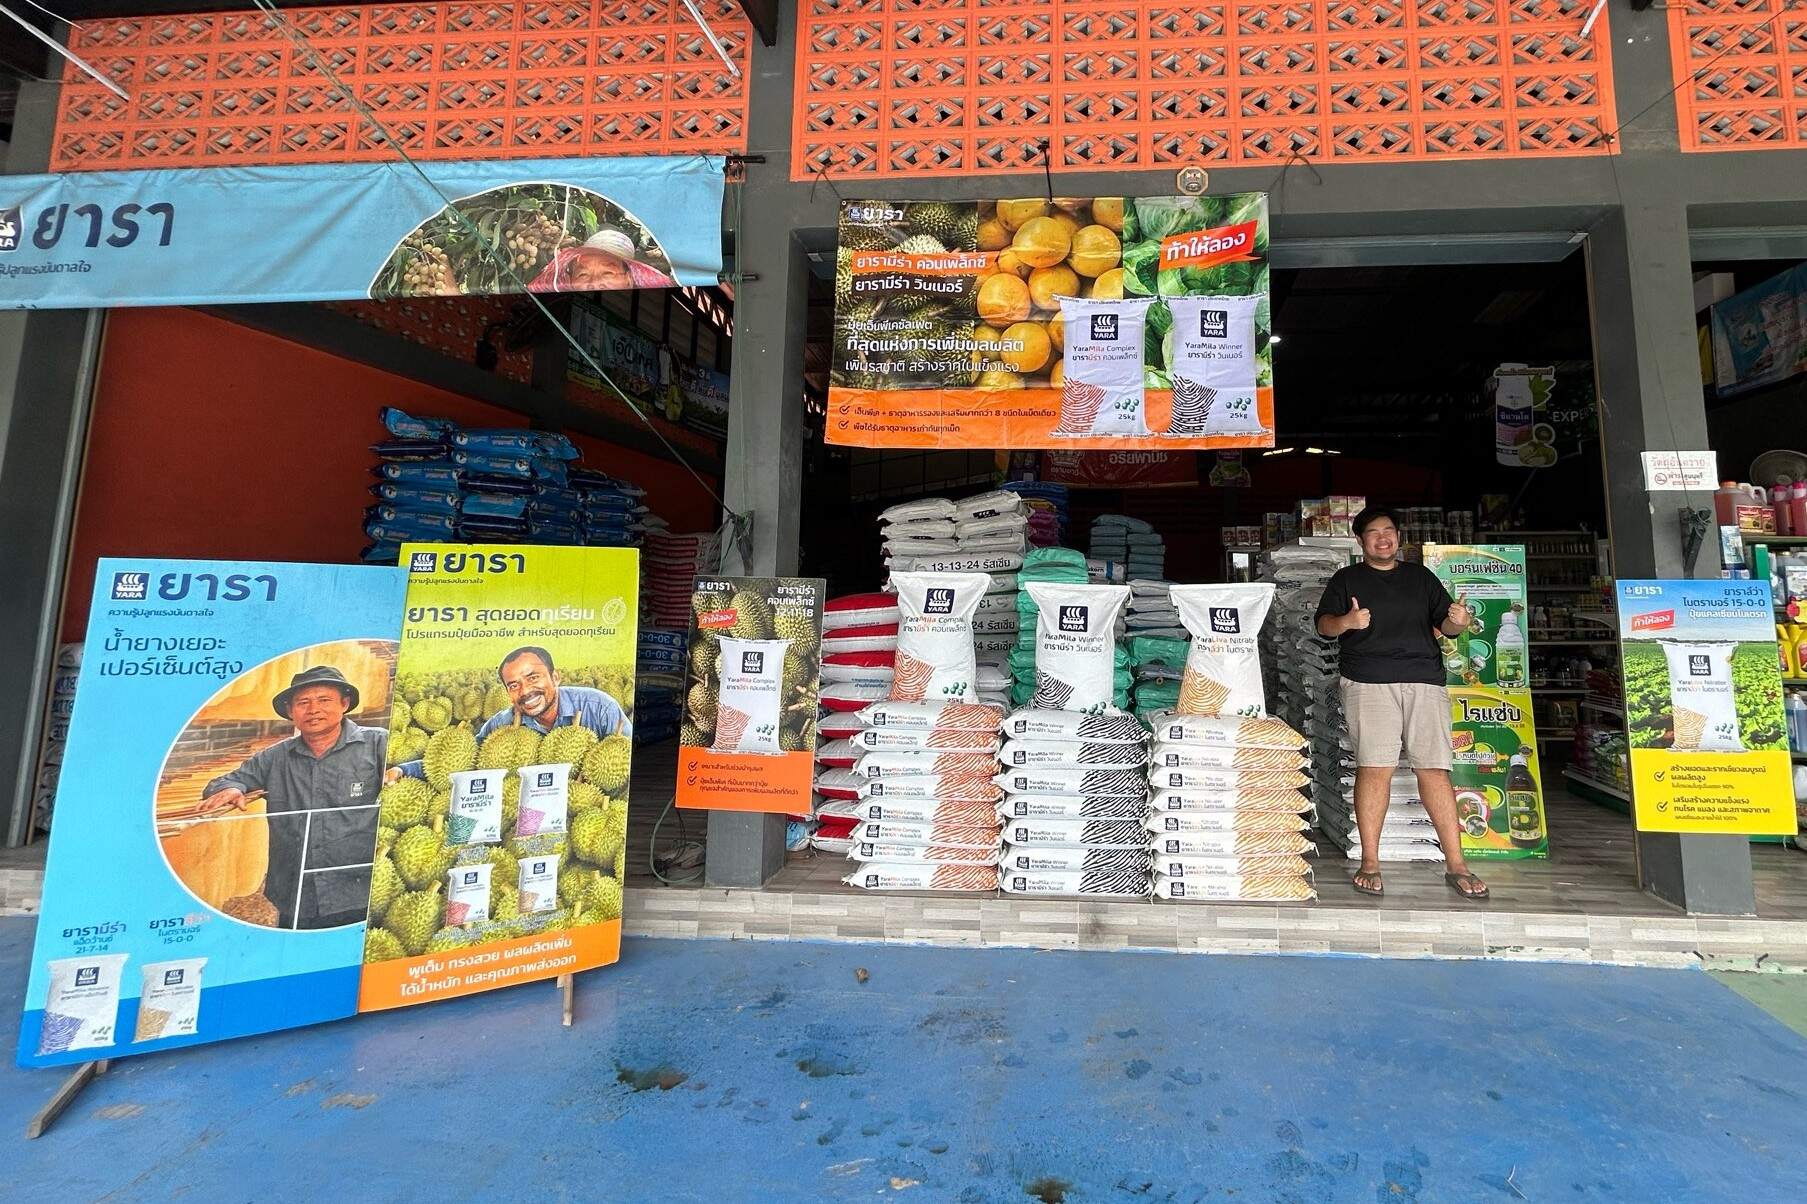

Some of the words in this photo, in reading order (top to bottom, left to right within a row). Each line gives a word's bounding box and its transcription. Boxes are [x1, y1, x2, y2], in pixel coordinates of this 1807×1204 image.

[863, 207, 904, 221] ยารา
[33, 202, 175, 250] ยารา
[1167, 232, 1246, 261] ท้าให้ลอง
[856, 256, 912, 268] ยารามีร่า
[916, 255, 986, 270] คอมเพล็กซ์
[855, 277, 910, 291] ยารามีร่า
[914, 278, 963, 293] วินเนอร์
[847, 332, 1024, 357] ที่สุดแห่งการเพิ่มผลผลิต
[1072, 353, 1101, 361] ยารามีร่า
[1187, 351, 1216, 359] ยารามีร่า
[845, 358, 905, 374] เพิ่มรสชาติ
[443, 553, 525, 573] ยารา
[931, 560, 980, 572] 13-13-24
[983, 557, 1011, 570] รัสเซีย
[1509, 563, 1522, 574] 40
[158, 572, 279, 601] ยารา
[706, 581, 730, 591] ยารา
[777, 586, 816, 596] ยารามีร่า
[1634, 585, 1663, 595] ยารา
[1724, 586, 1764, 596] ยาราลีว่า
[115, 591, 143, 599] YARA
[1683, 596, 1729, 607] ไนตราบอร์
[1731, 598, 1766, 607] 15-0-0
[408, 605, 469, 623] ยารา
[475, 603, 596, 626] สุดยอดทุเรียน
[1634, 614, 1670, 627] ท้าให้ลอง
[104, 627, 227, 652] น้ำยางเยอะ
[407, 627, 515, 640] โปรแกรมปุ๋ยมืออาชีพ
[518, 625, 616, 639] สำหรับสุดยอดทุเรียน
[100, 654, 244, 680] เปอร์เซ็นต์สูง
[1459, 698, 1522, 723] ไรแซ่บ
[62, 921, 127, 938] ยารามีร่า
[163, 934, 194, 945] 15-0-0
[75, 945, 109, 955] 21-7-14
[408, 960, 444, 978] พูเต็ม
[449, 952, 500, 969] ทรงสวย
[504, 935, 573, 960] ผลผลิตเพิ่ม
[400, 974, 461, 997] ได้น้ำหนัก
[465, 953, 577, 985] และคุณภาพส่งออก
